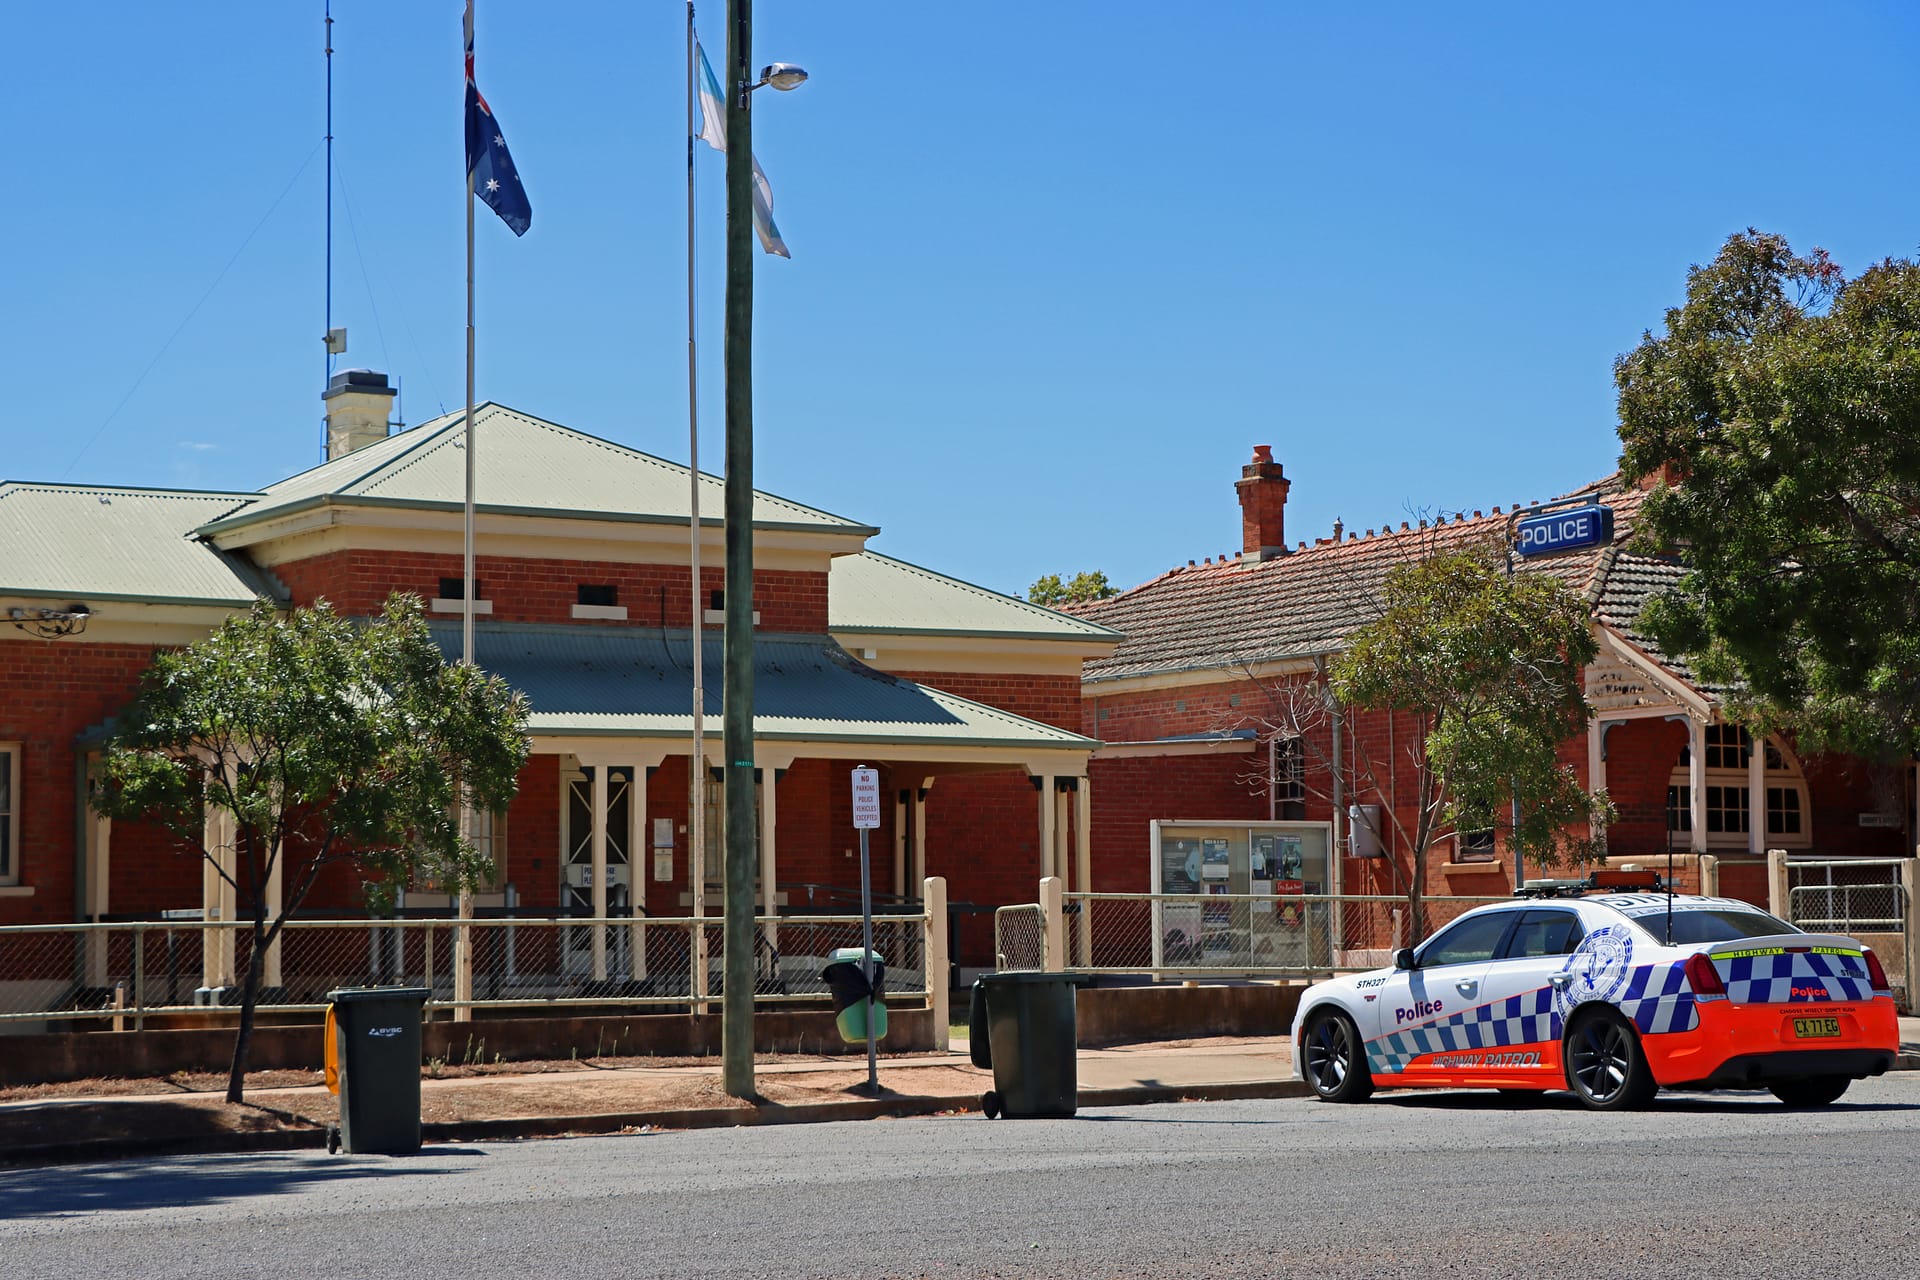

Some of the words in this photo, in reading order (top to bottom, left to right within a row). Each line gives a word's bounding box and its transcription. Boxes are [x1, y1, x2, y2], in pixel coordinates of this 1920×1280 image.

[1521, 518, 1589, 548] POLICE
[1732, 947, 1783, 958] HIGHWAY
[1813, 947, 1845, 955] PATROL
[1356, 978, 1386, 988] STH327
[1791, 986, 1828, 997] Police
[1395, 999, 1443, 1025] Police
[1795, 1020, 1809, 1033] CX
[1810, 1019, 1823, 1033] 77
[1824, 1019, 1838, 1032] EG
[1431, 1055, 1482, 1067] HIGHWAY
[1484, 1051, 1541, 1067] PATROL
